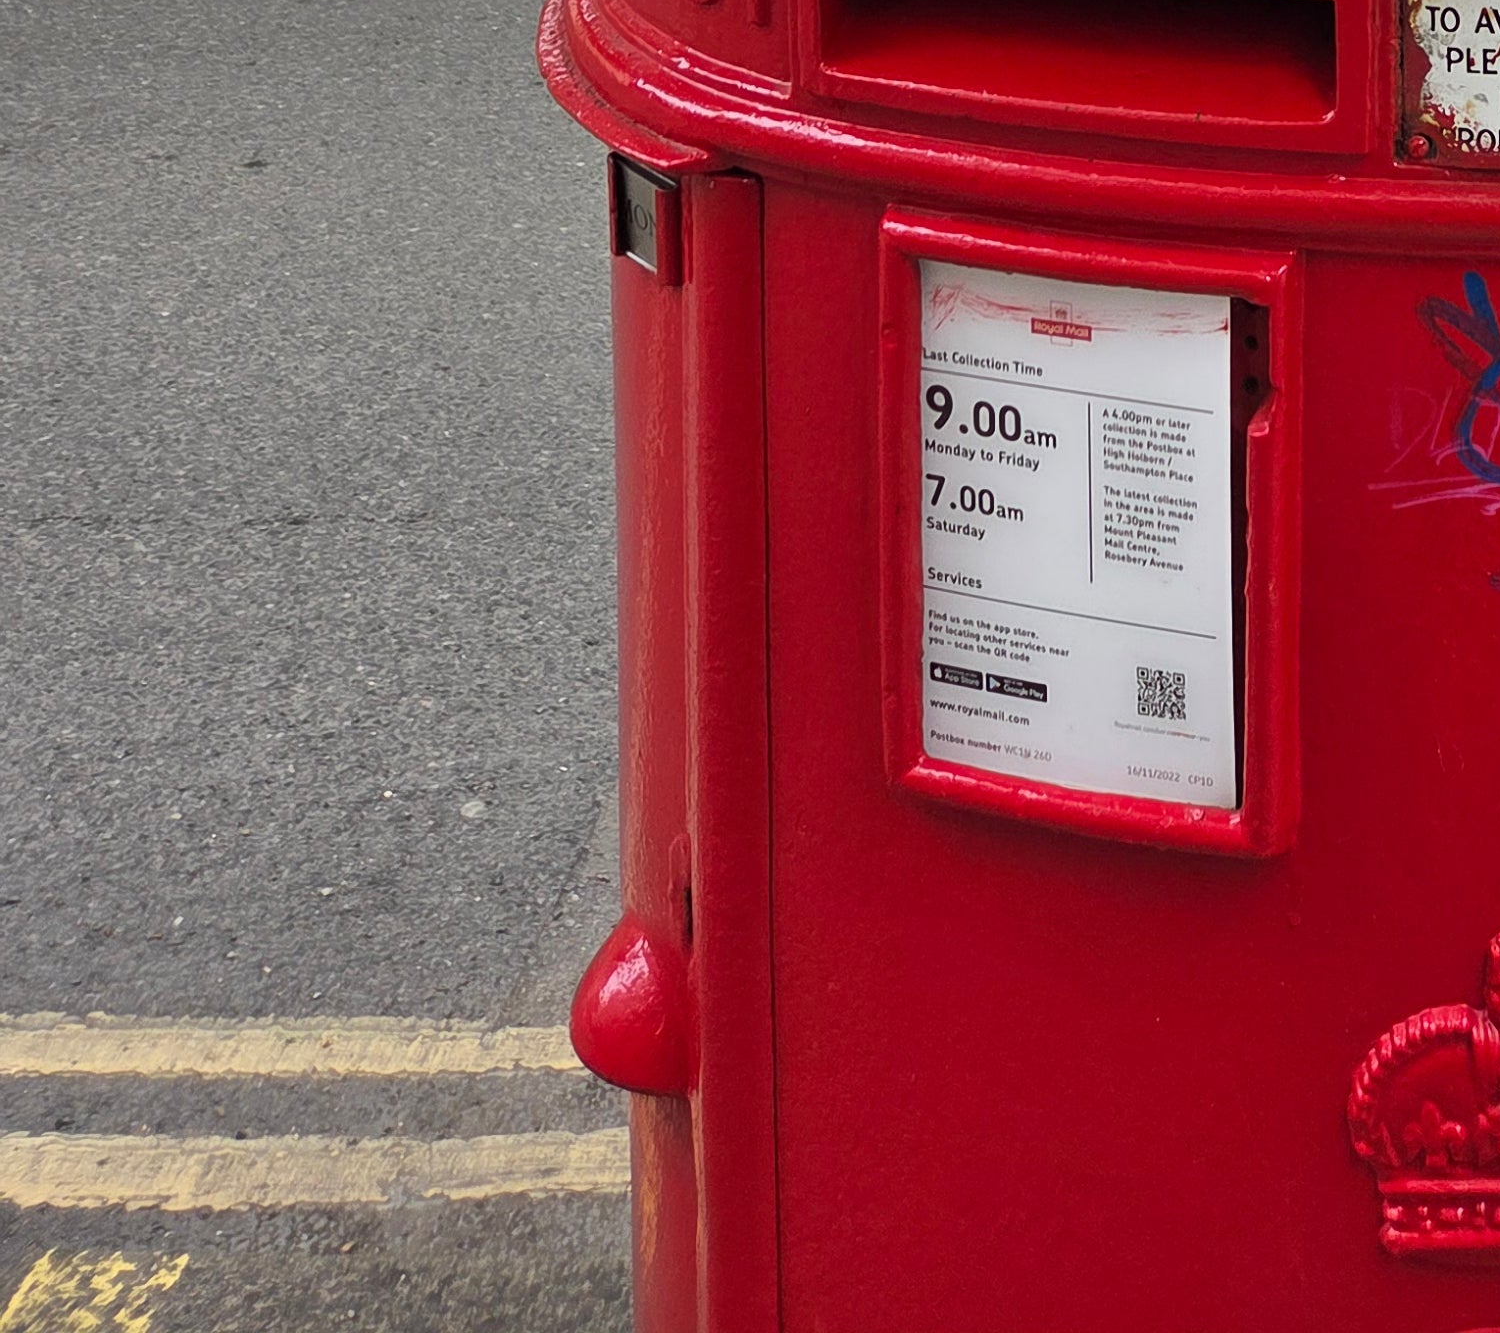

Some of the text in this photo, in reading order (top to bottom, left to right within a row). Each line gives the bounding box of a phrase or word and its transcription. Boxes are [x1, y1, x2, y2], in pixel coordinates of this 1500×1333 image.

[1426, 5, 1461, 32] TO
[1033, 320, 1089, 338] Royal Mail
[923, 348, 1042, 376] Last Collection Time
[926, 385, 1057, 449] 9.00am
[1103, 408, 1190, 430] A 4.00pm or later
[1103, 423, 1186, 442] collection is made
[925, 439, 1040, 471] Monday to Friday
[1103, 434, 1195, 457] from the Postbox at
[1104, 447, 1165, 465] High Holborn
[1104, 460, 1193, 482] Southampton Place
[926, 473, 1024, 522] 7.00am
[1104, 486, 1197, 509] The latest collection
[1104, 498, 1193, 521] in the area is made
[927, 517, 986, 540] Saturday
[1104, 513, 1180, 533] at 7.30pm from
[1104, 525, 1176, 545] Mount Pleasant
[1105, 538, 1160, 555] Mail Centre,
[1105, 550, 1183, 571] Rosebery Avenue
[928, 567, 982, 589] Services
[929, 610, 1039, 639] Find us on the app store.
[929, 622, 1069, 657] For locating other services near
[929, 637, 1030, 662] you scan the QR code
[930, 698, 1029, 725] www.royalmail.com
[930, 730, 1001, 753] Postbox number
[1128, 765, 1180, 782] 16/11/2022
